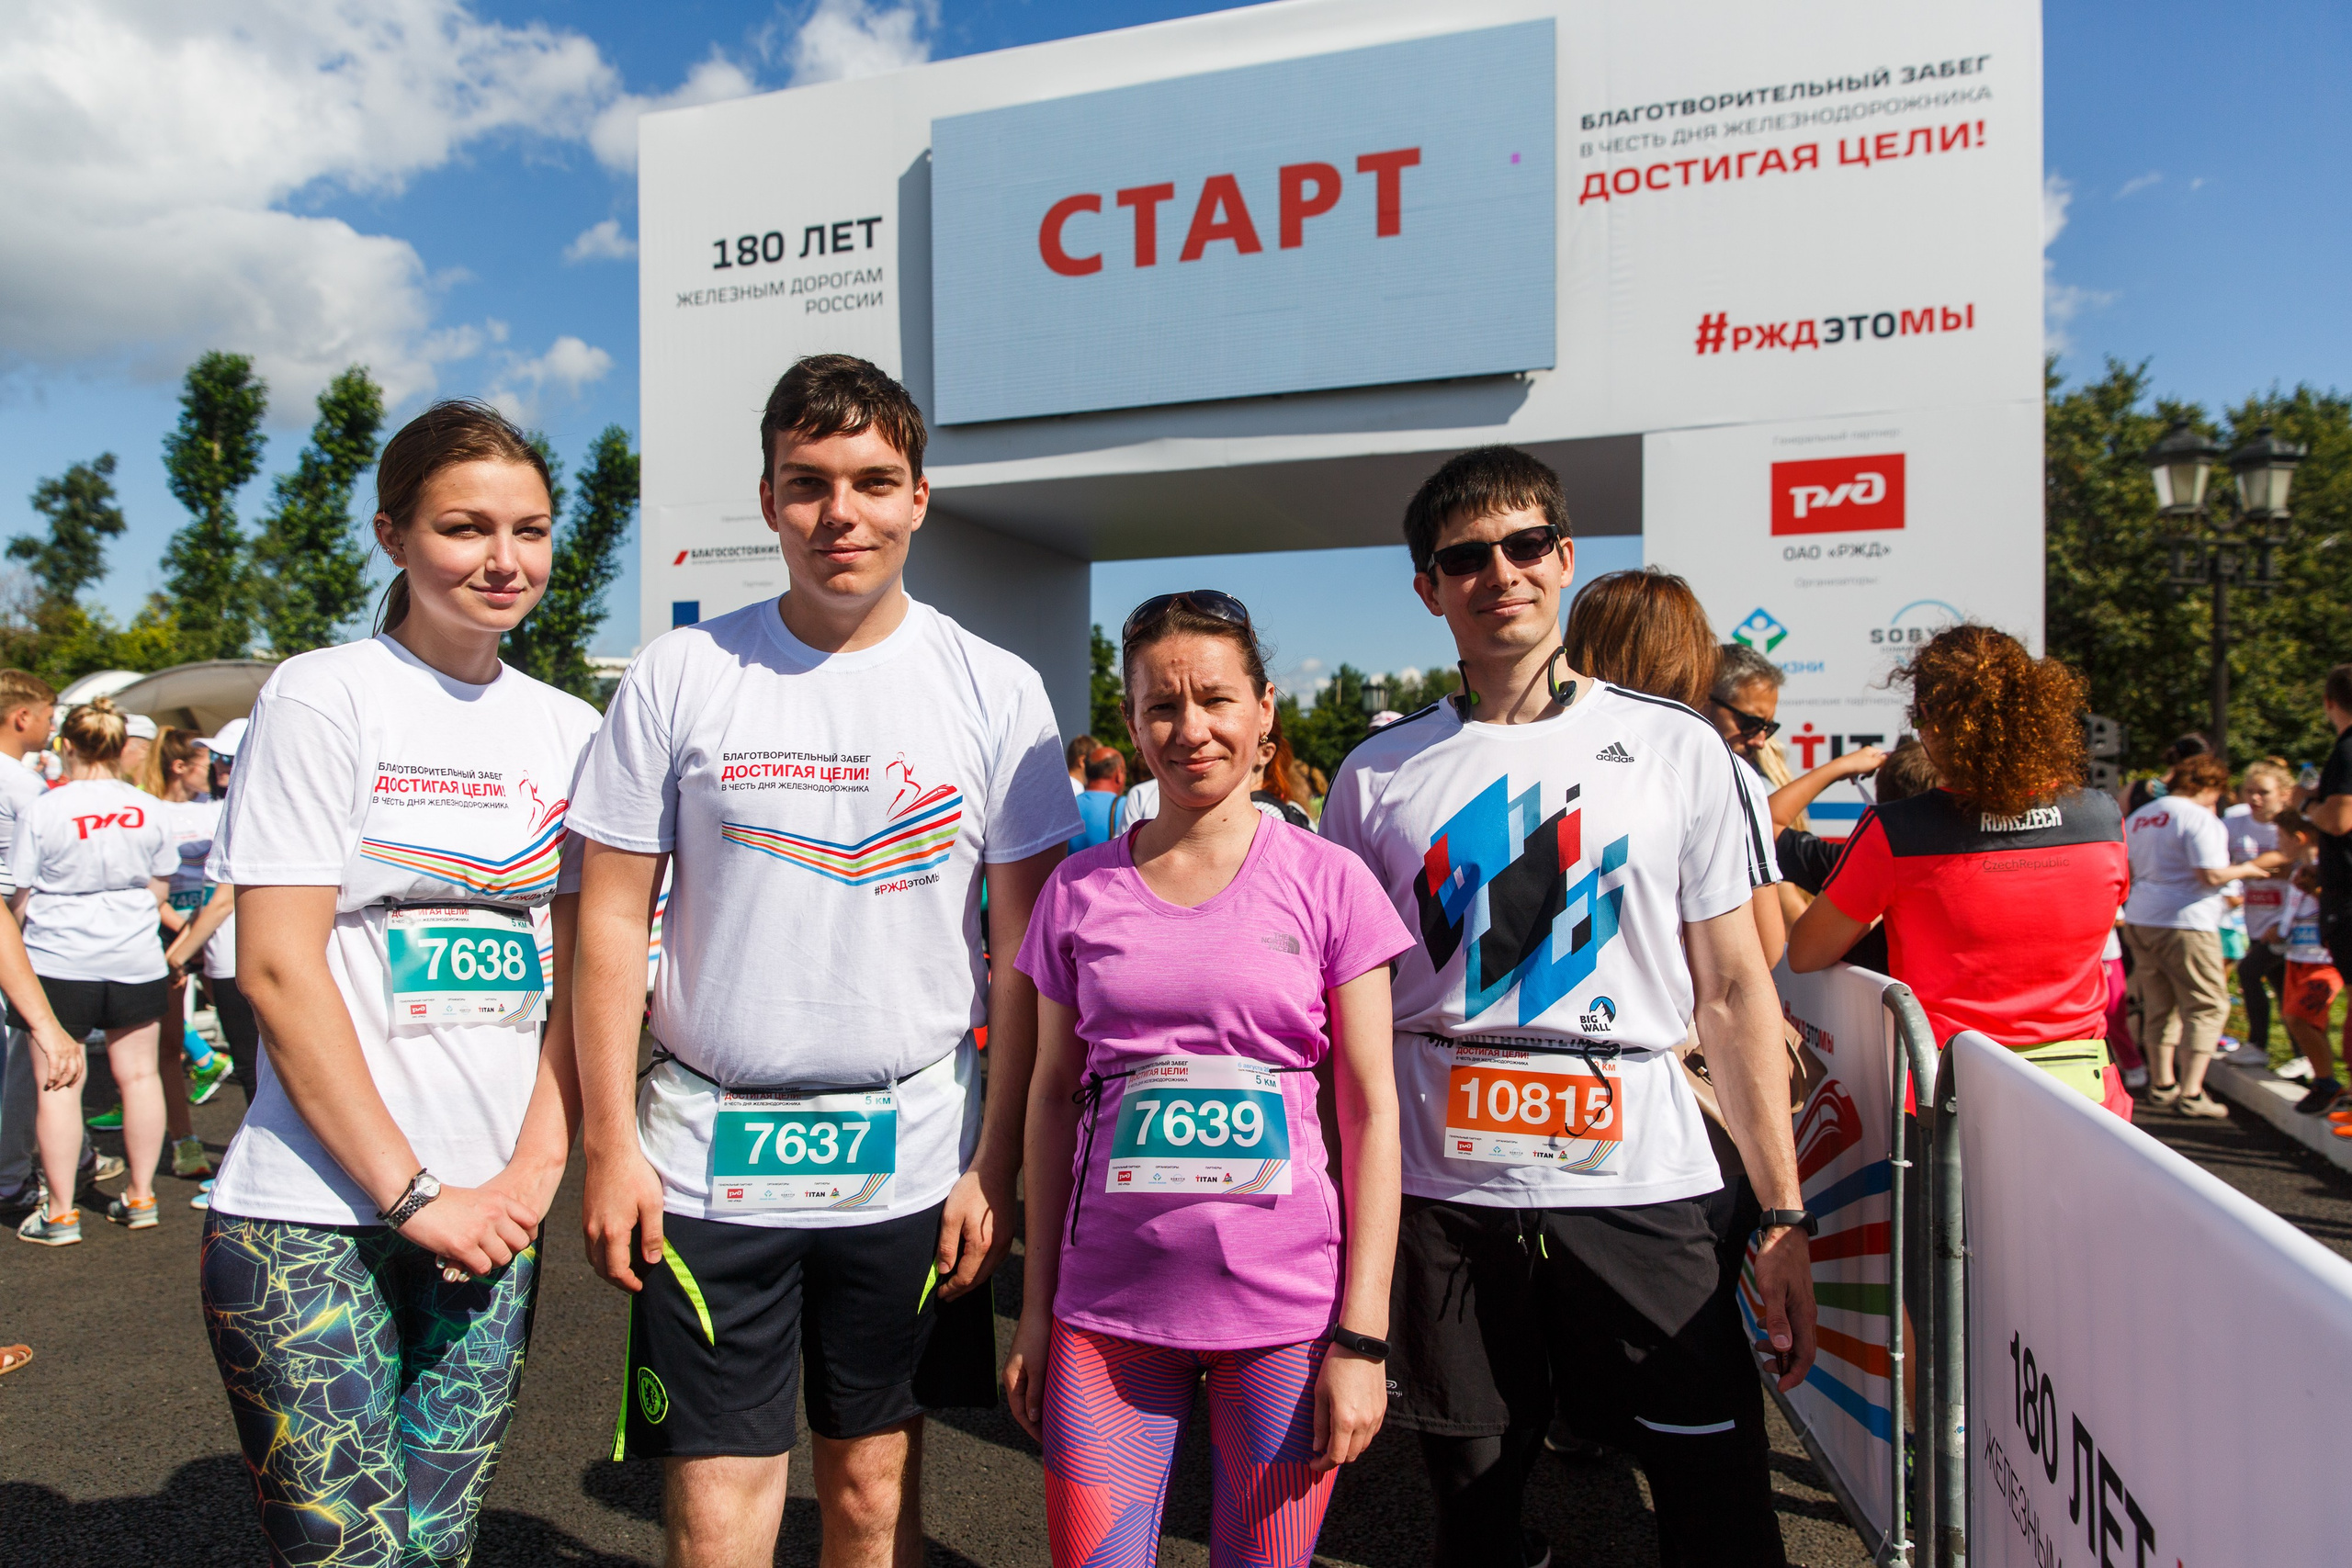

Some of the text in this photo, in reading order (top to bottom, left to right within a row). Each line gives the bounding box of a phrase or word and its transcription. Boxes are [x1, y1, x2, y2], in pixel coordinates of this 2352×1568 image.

[1580, 54, 1991, 131] БЛАГОТВОРИТЕЛЬНЫЙ ЗАБЕГ
[1579, 85, 1993, 158] В ЧЕСТЬ ДНЯ ЖЕЛЕЗНОДОРОЖНИКА
[1579, 119, 1987, 205] ДОСТИГАЯ ЦЕЛИ!
[1039, 147, 1421, 277] СТАРТ
[712, 216, 884, 271] 180 ЛЕТ
[676, 266, 884, 309] ЖЕЛЕЗНЫМ ДОРОГАМ
[805, 290, 884, 316] РОССИИ
[1783, 542, 1893, 561] ОАО «РЖД»
[1871, 627, 1937, 644] SOBY
[1779, 661, 1825, 673] ИЗНИ
[1791, 723, 1914, 770] TIT
[723, 750, 871, 763] БЛАГОТВОРИТЕЛЬНЫЙ ЗАБЕГ
[1596, 754, 1634, 762] adidas
[478, 771, 503, 781] ЗАБЕГ
[721, 763, 869, 783] ДОСТИГАЯ ЦЕЛИ!
[374, 775, 506, 798] ДОСТИГАЯ ЦЕЛИ!
[721, 782, 869, 793] В ЧЕСТЬ ДНЯ ЖЕЛЕЗНОДОРОЖНИКА
[381, 797, 404, 807] ЧЕСТЬ
[407, 798, 426, 807] ДНЯ
[427, 798, 509, 809] ЖЕЛЕЗНОДОРОЖНИКА
[445, 908, 469, 917] ЦЕЛИ!
[511, 919, 516, 927] 5
[418, 938, 526, 981] 7638
[1580, 1015, 1598, 1024] BIG
[1581, 1023, 1611, 1032] WALL
[1456, 1047, 1530, 1059] ДОСТИГАЯ ЦЕЛИ!
[1129, 1067, 1189, 1083] ДОСТИГАЯ ЦЕЛИ!
[1256, 1075, 1261, 1084] 5
[725, 1092, 801, 1100] ДОСТИГАЯ ЦЕЛИ!
[865, 1096, 872, 1105] 5
[1461, 1077, 1614, 1129] 10815
[1135, 1100, 1264, 1147] 7639
[744, 1122, 871, 1165] 7637
[1532, 1150, 1554, 1158] TITAN
[1195, 1175, 1217, 1183] TITAN
[2009, 1329, 2156, 1568] 180 ЛЕТ
